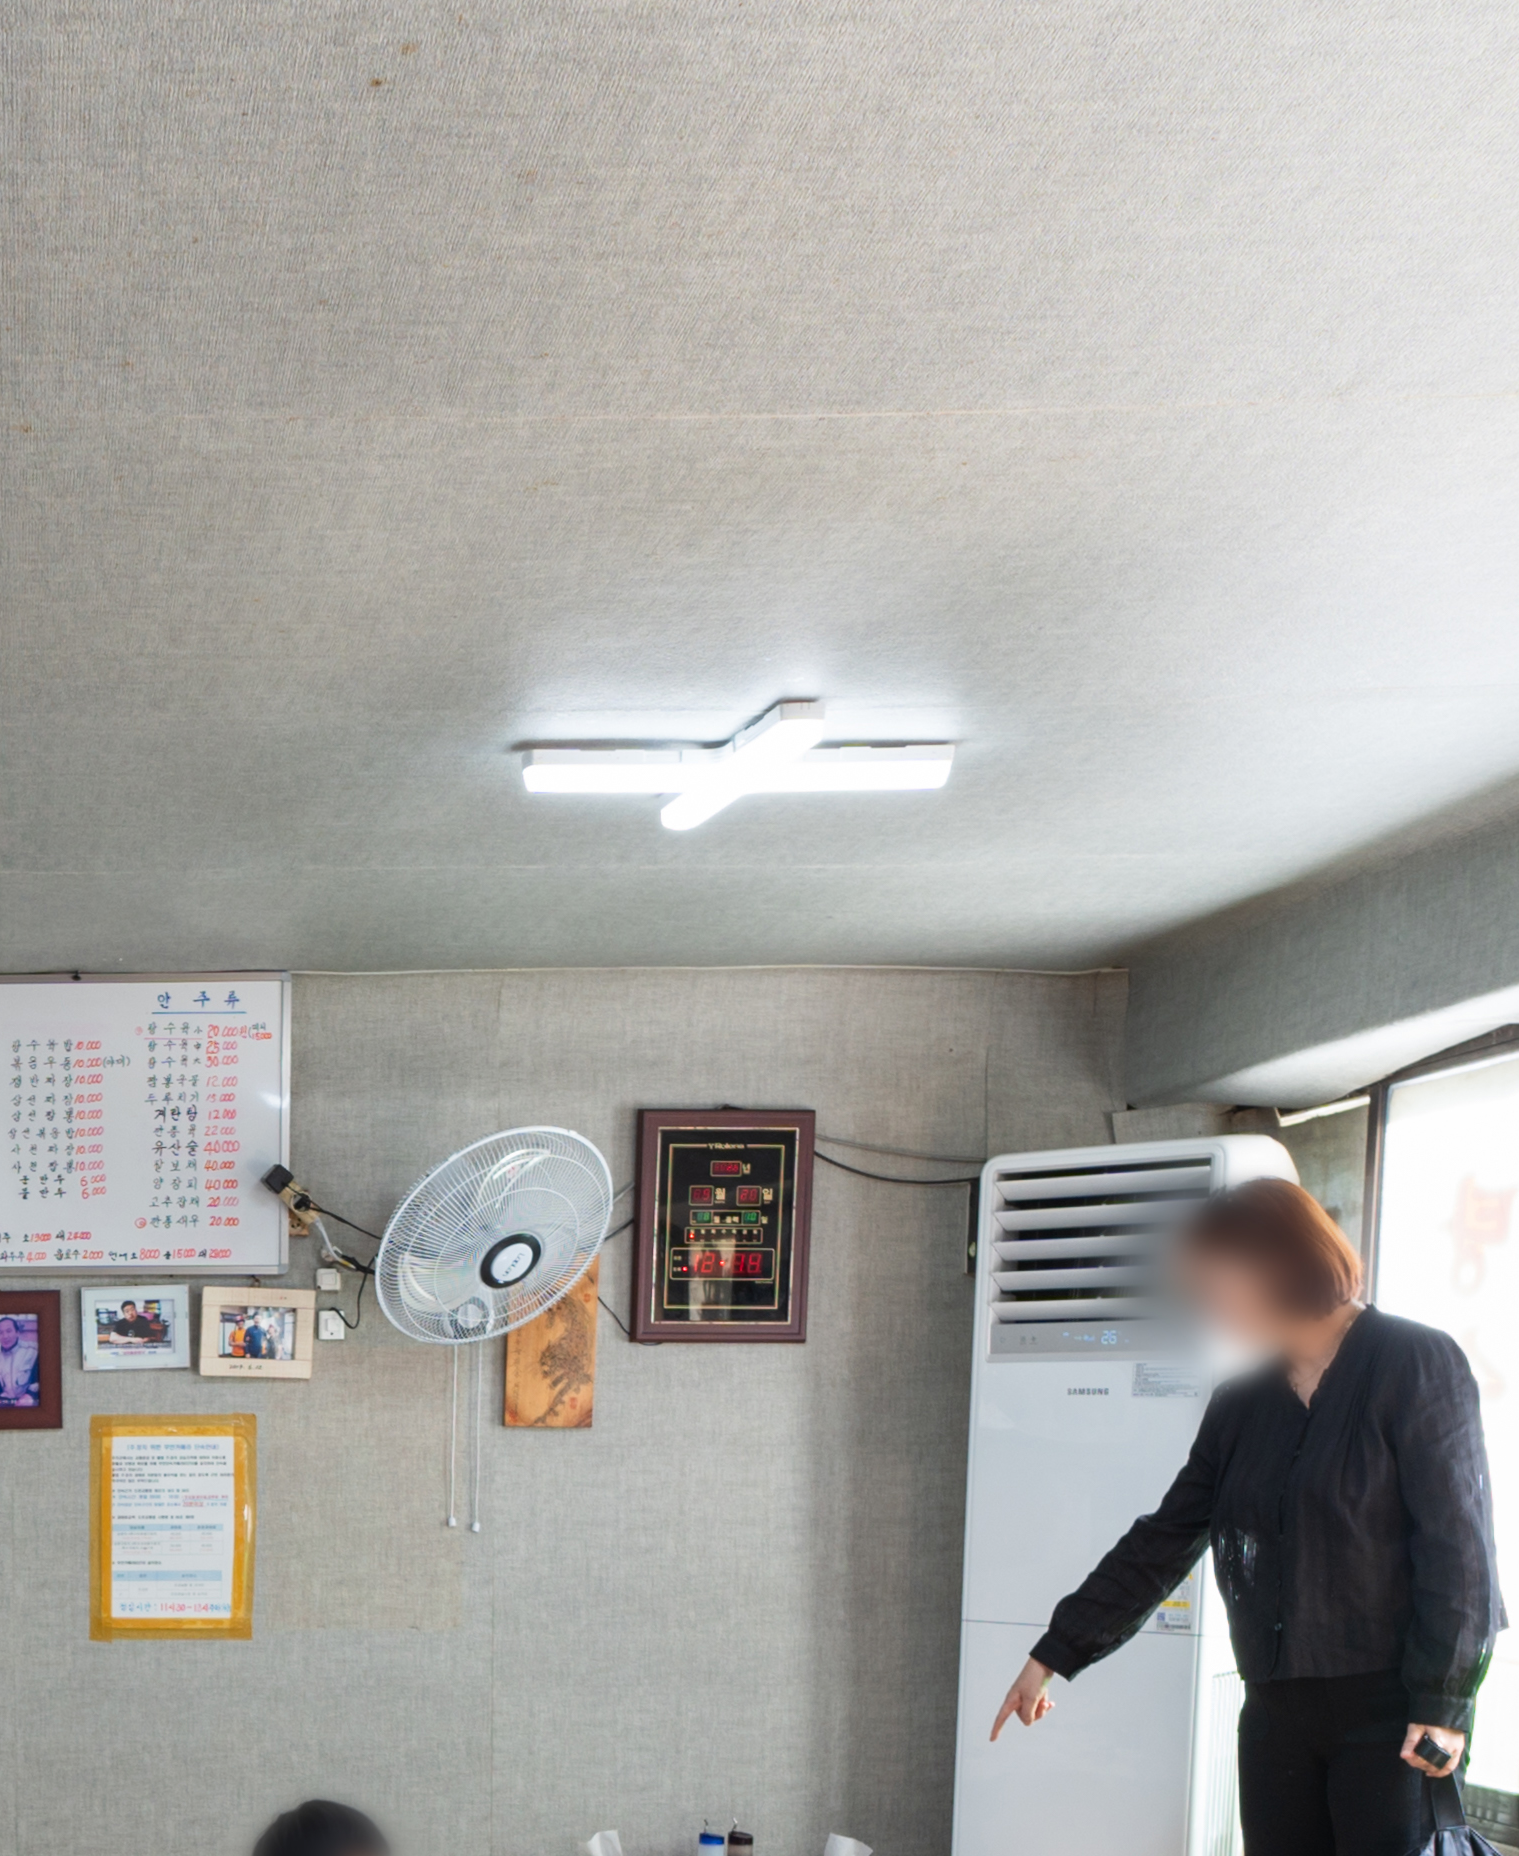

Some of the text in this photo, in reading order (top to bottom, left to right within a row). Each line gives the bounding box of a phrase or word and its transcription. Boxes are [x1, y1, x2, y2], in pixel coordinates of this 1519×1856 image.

[157, 991, 240, 1009] 안주류
[154, 1104, 198, 1123] 계란탕
[152, 1139, 199, 1157] 유산슬
[153, 1176, 197, 1191] 양장피
[149, 1195, 200, 1209] 고추잡채
[1100, 1330, 1118, 1345] 26
[1067, 1387, 1110, 1396] SAMSUNG
